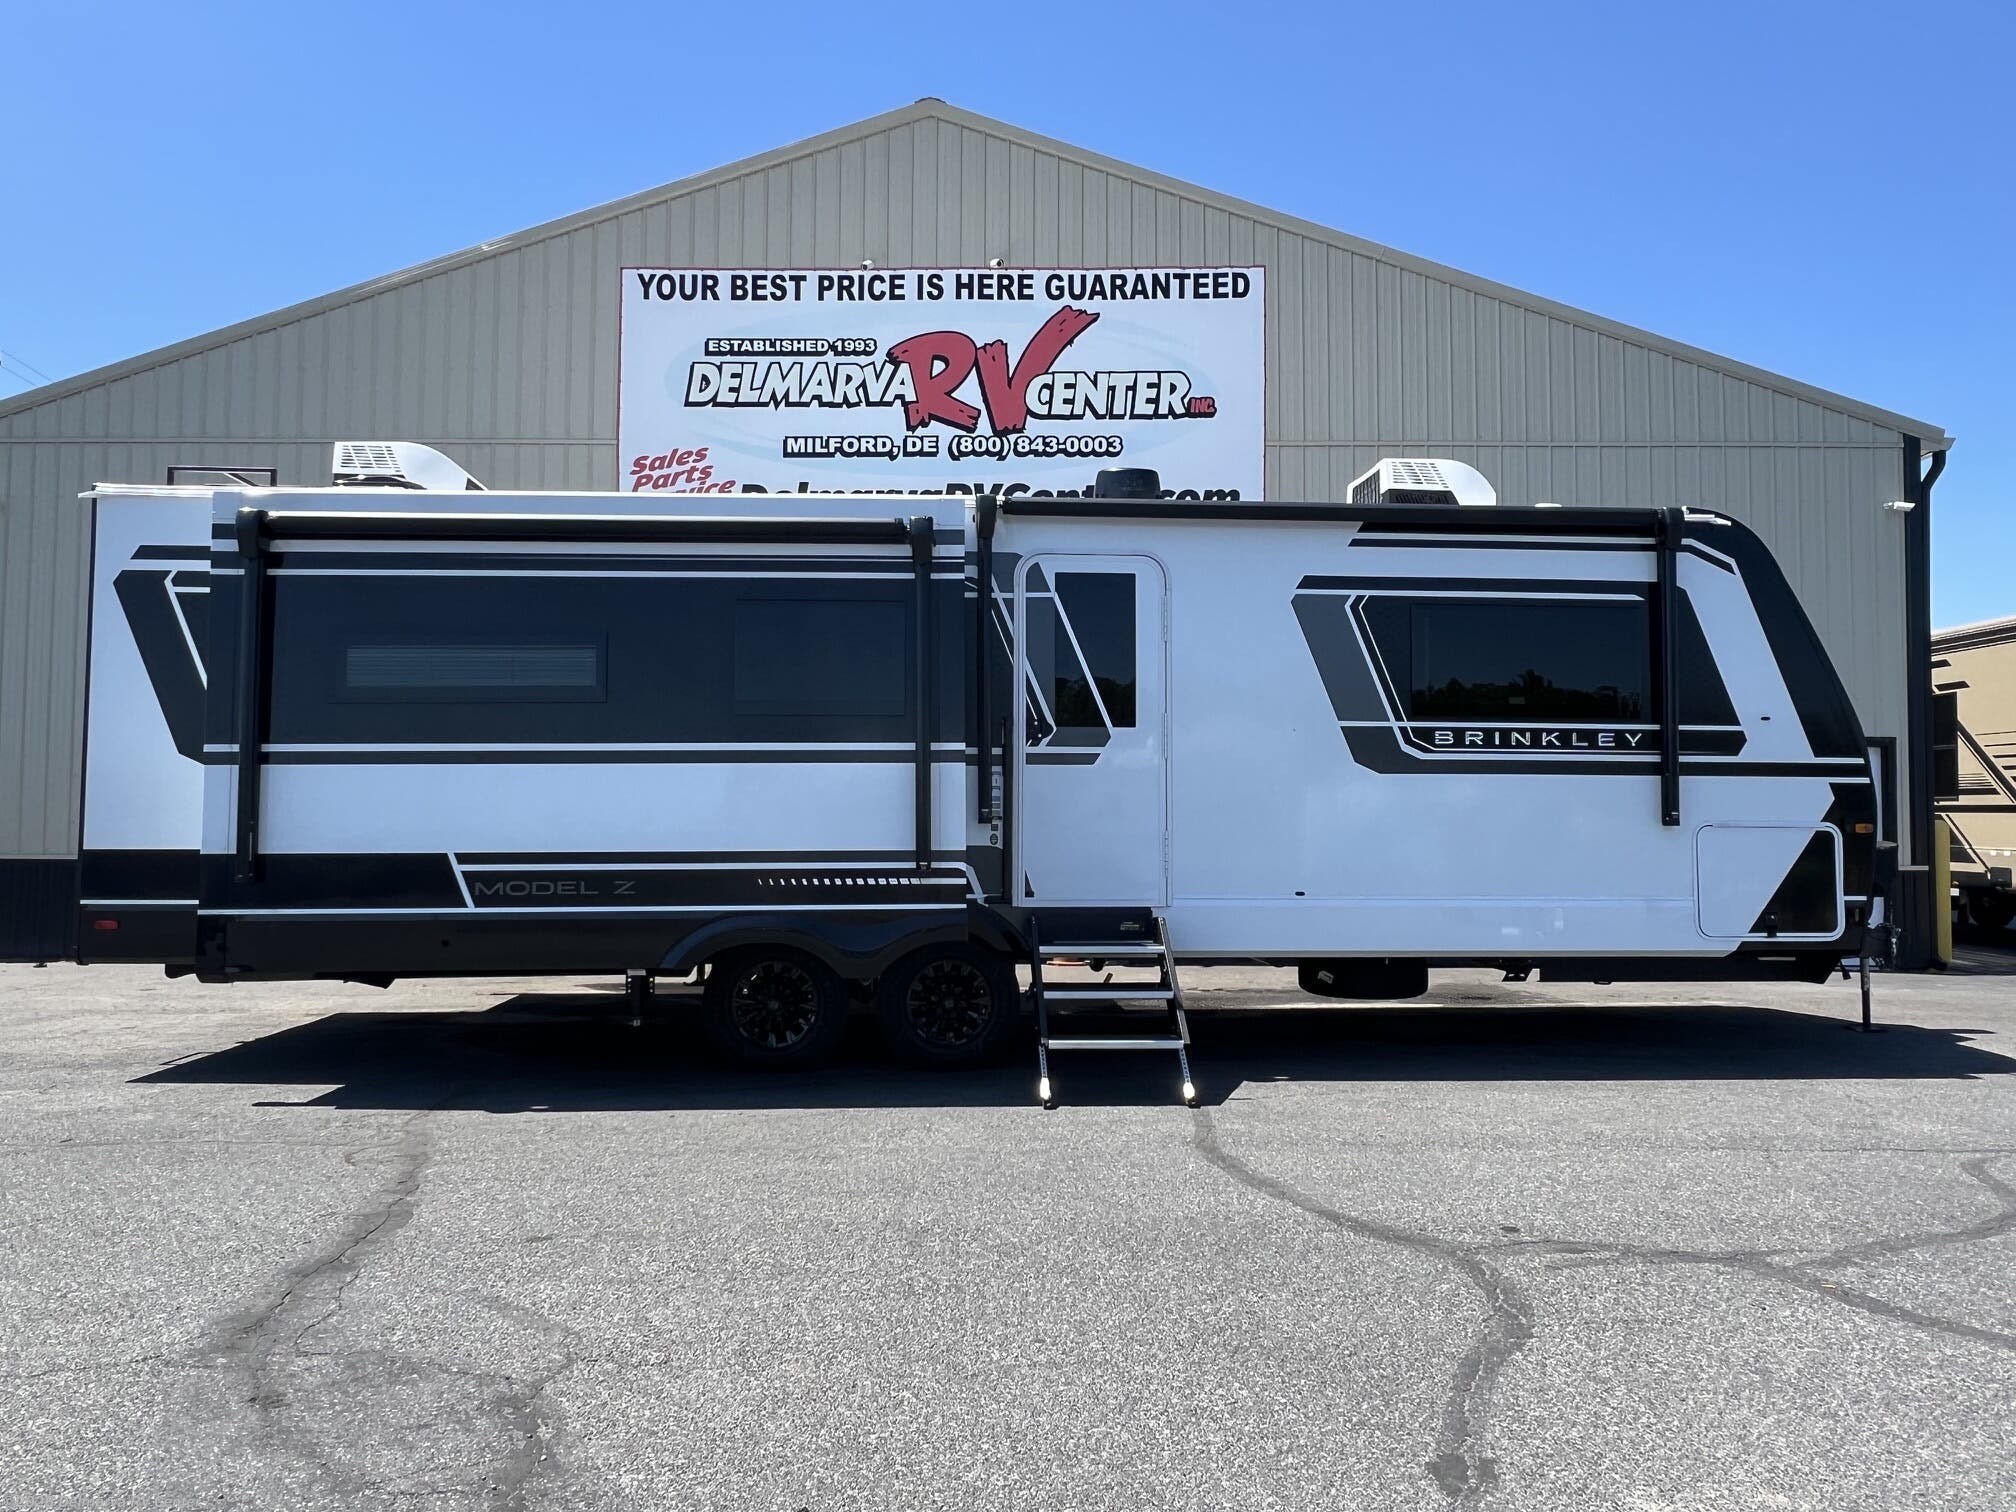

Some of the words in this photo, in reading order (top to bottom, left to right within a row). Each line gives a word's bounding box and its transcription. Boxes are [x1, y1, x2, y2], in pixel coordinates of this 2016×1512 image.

[637, 273, 720, 301] YOUR
[730, 274, 807, 301] BEST
[817, 274, 906, 301] PRICE
[917, 273, 944, 301] IS
[955, 273, 1034, 301] HERE
[1045, 272, 1250, 300] GUARANTEED
[706, 338, 829, 354] ESTABLISHED
[833, 338, 877, 354] 1993
[685, 361, 918, 408] DELMARVA
[886, 305, 1100, 435] RV
[1026, 371, 1191, 419] CENTER
[630, 447, 709, 475] Sales
[784, 436, 899, 460] MILFORD,
[903, 436, 939, 457] DE
[949, 436, 1011, 461] (800)
[1014, 436, 1123, 457] 843-0003
[632, 465, 714, 493] Parts
[1434, 730, 1643, 747] BRINKLEY
[474, 880, 600, 896] MODEL
[612, 880, 637, 895] Z
